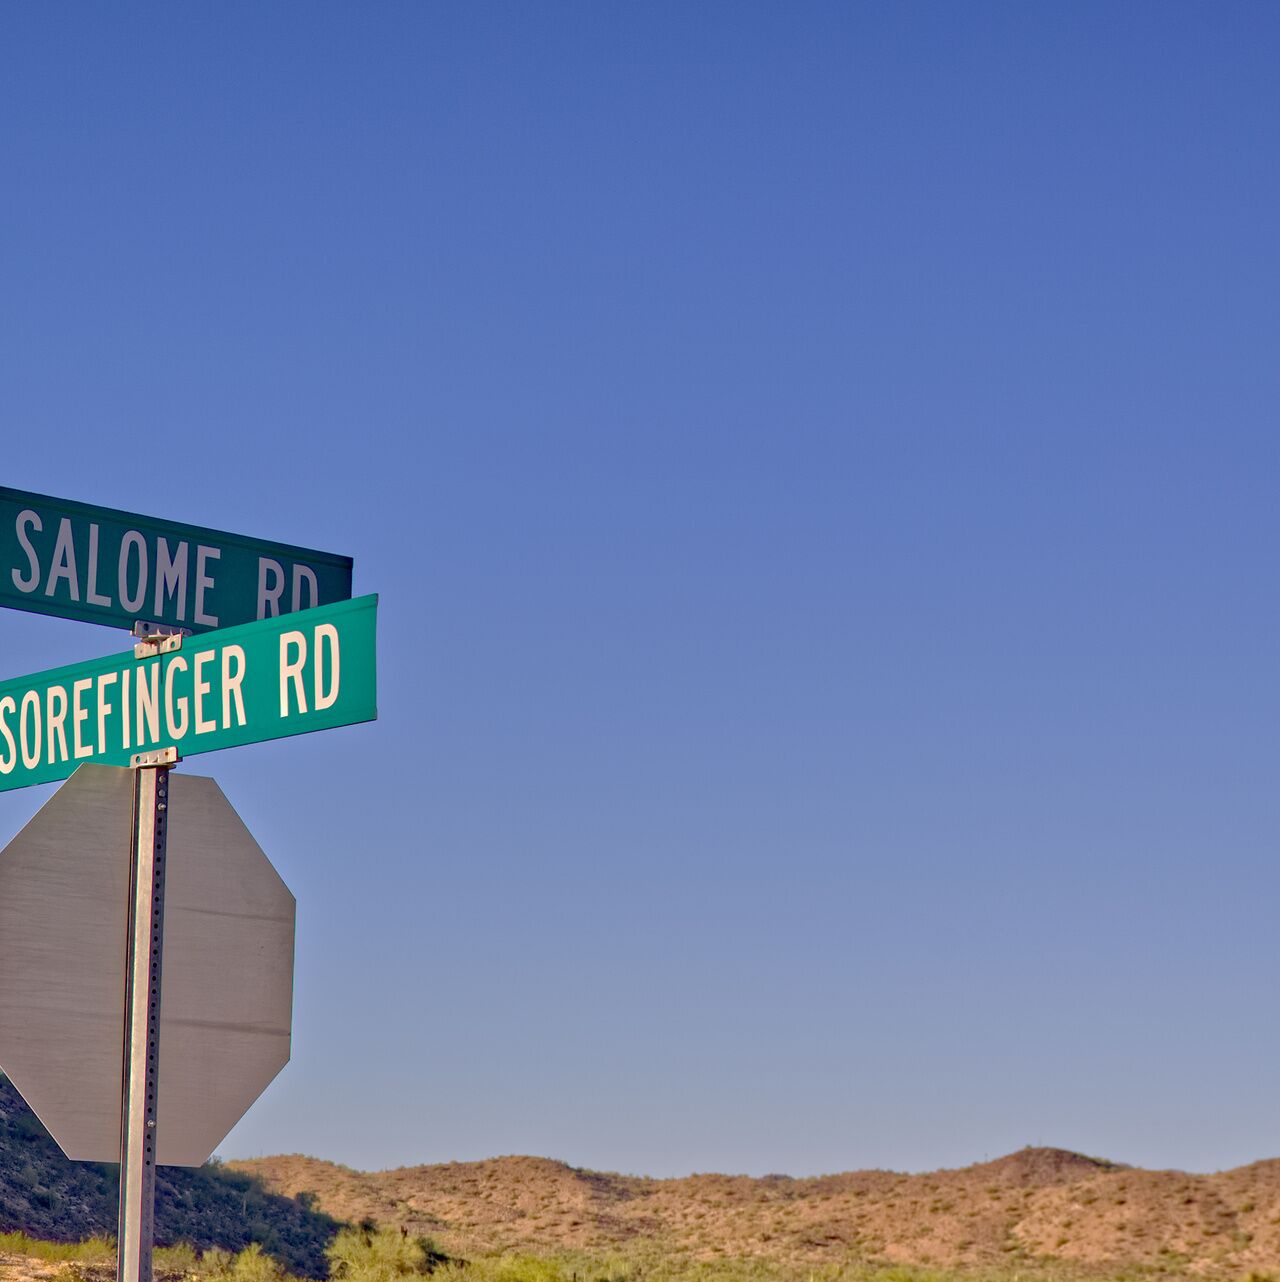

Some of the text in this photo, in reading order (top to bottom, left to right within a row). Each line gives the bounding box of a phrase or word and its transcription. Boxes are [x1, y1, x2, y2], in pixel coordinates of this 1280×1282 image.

[11, 509, 319, 628] SALOME RD
[279, 623, 340, 719] RD
